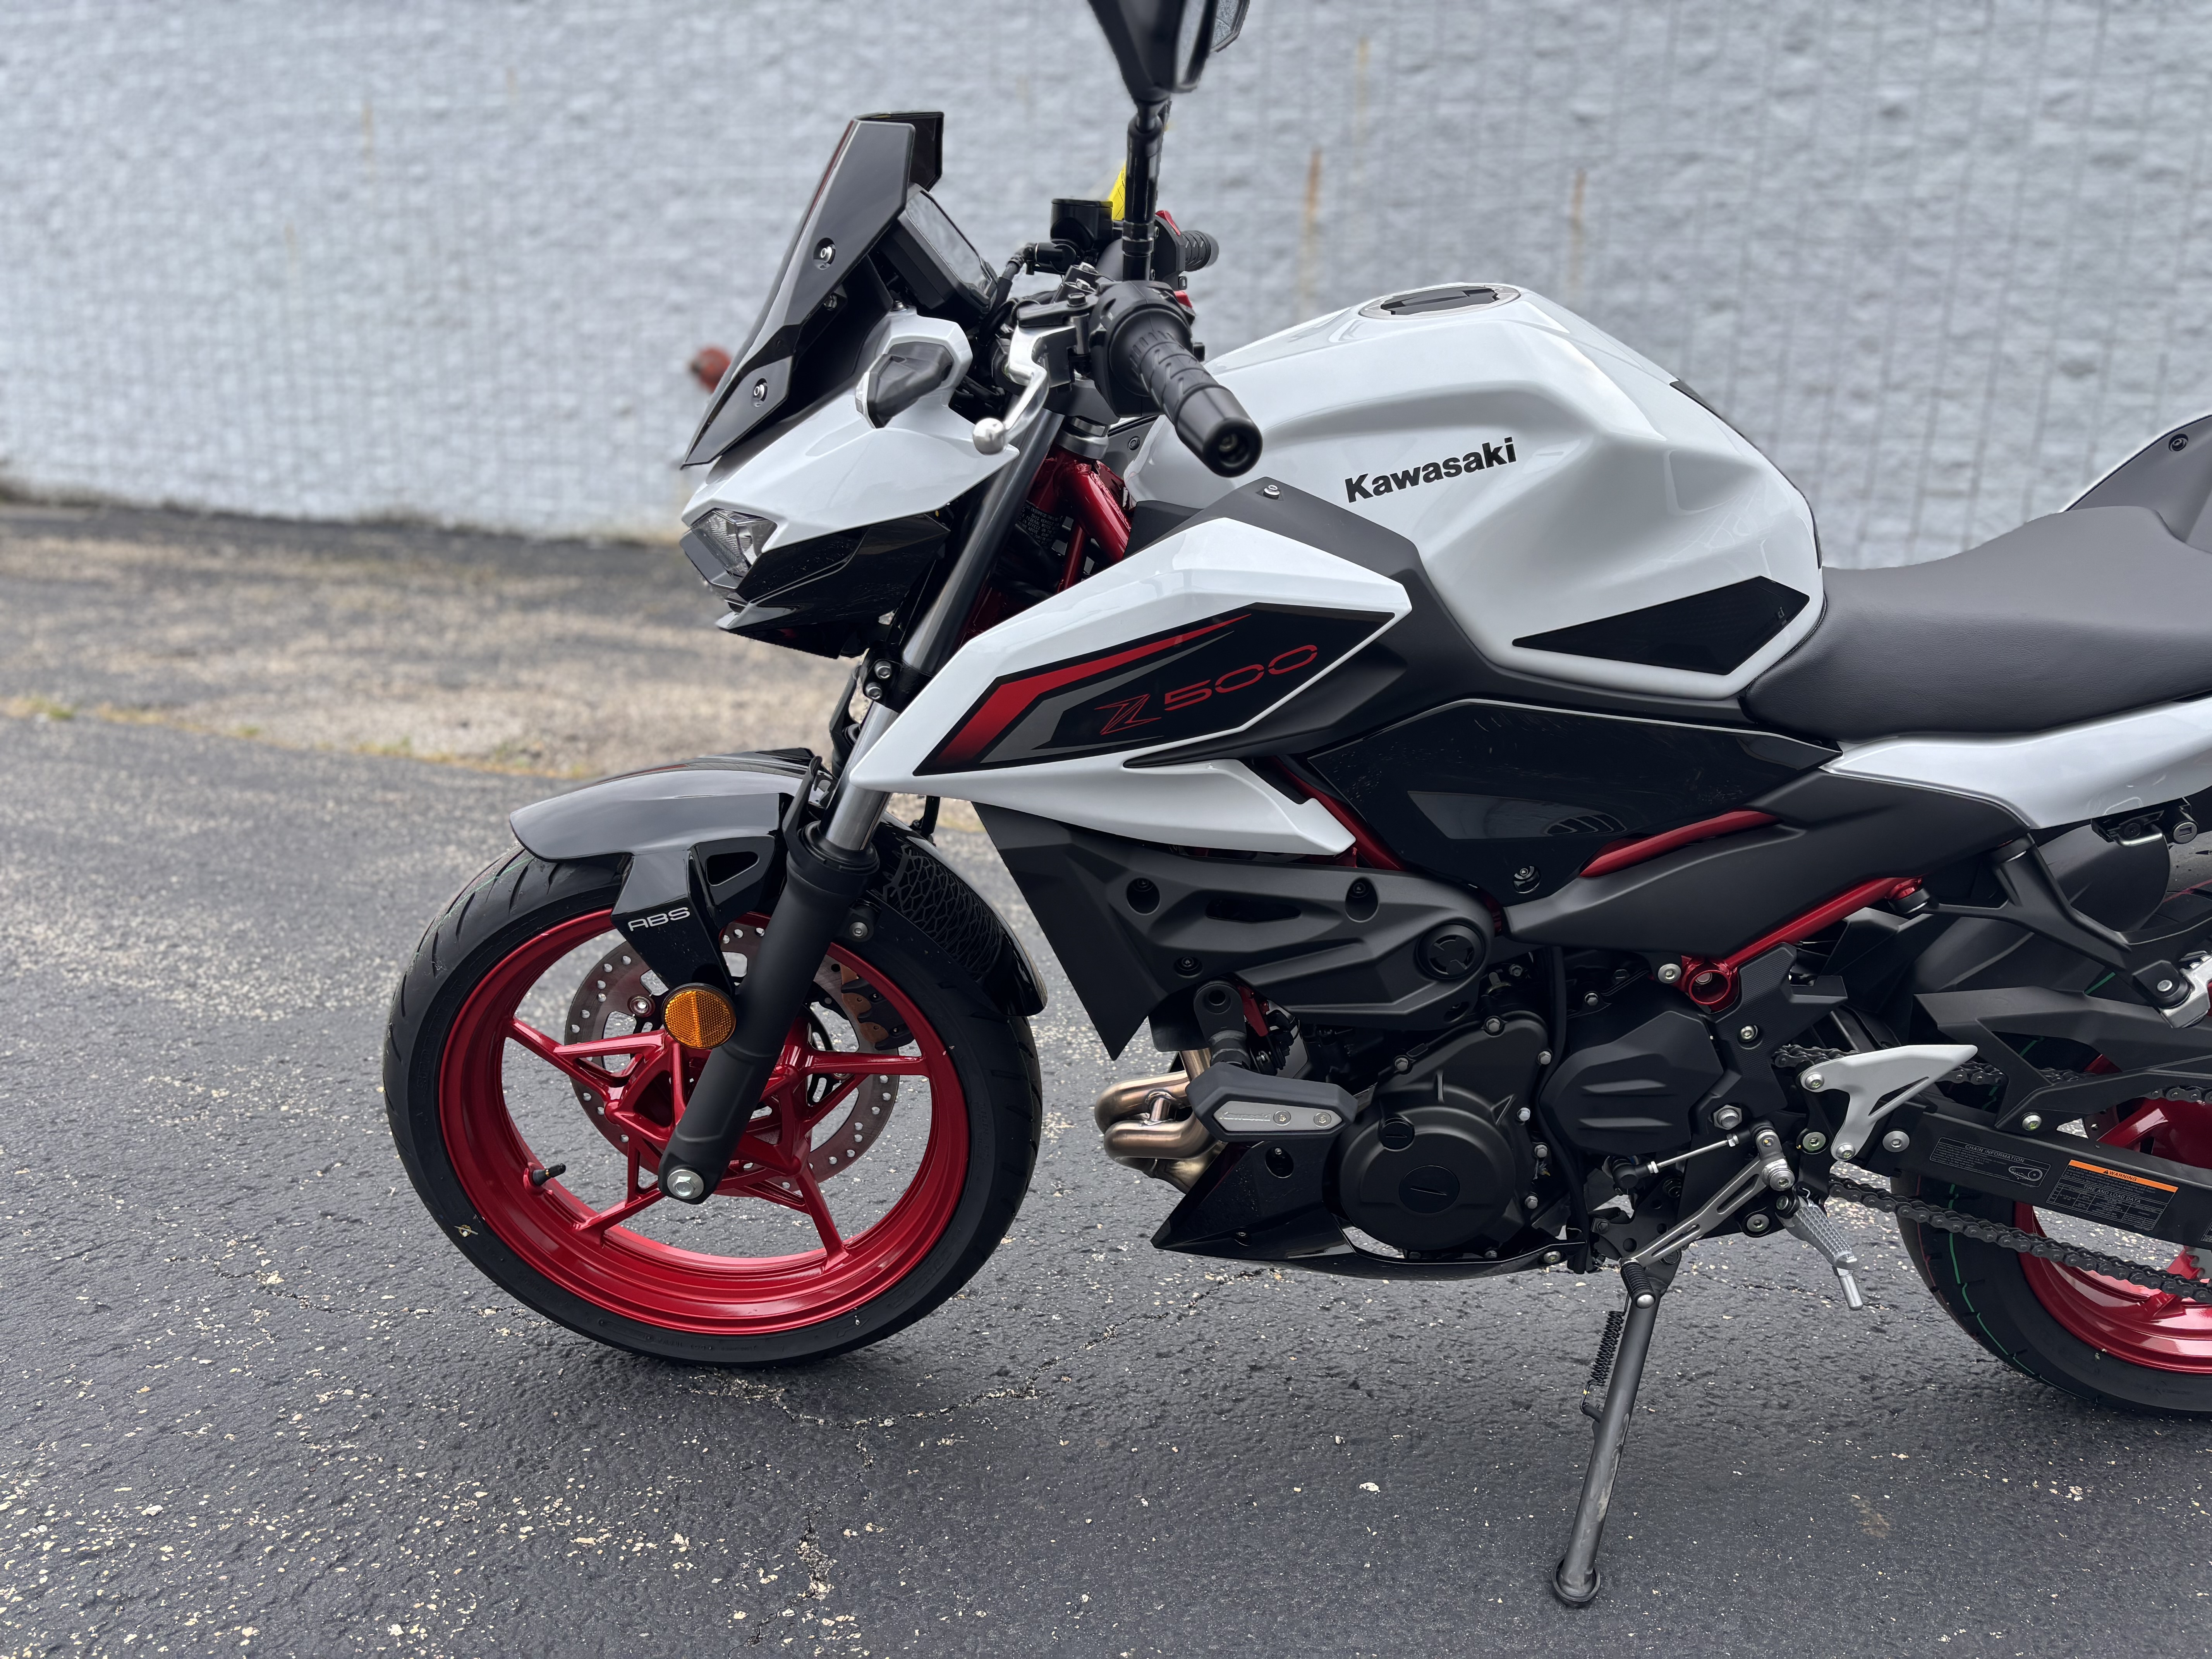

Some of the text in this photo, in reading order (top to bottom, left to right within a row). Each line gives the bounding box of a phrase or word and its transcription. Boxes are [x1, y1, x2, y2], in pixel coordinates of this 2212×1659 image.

[1345, 436, 1516, 503] Kawasaki
[628, 907, 690, 932] ABS
[1984, 1149, 2025, 1163] INFORMATION
[2109, 1170, 2137, 1181] WARNING
